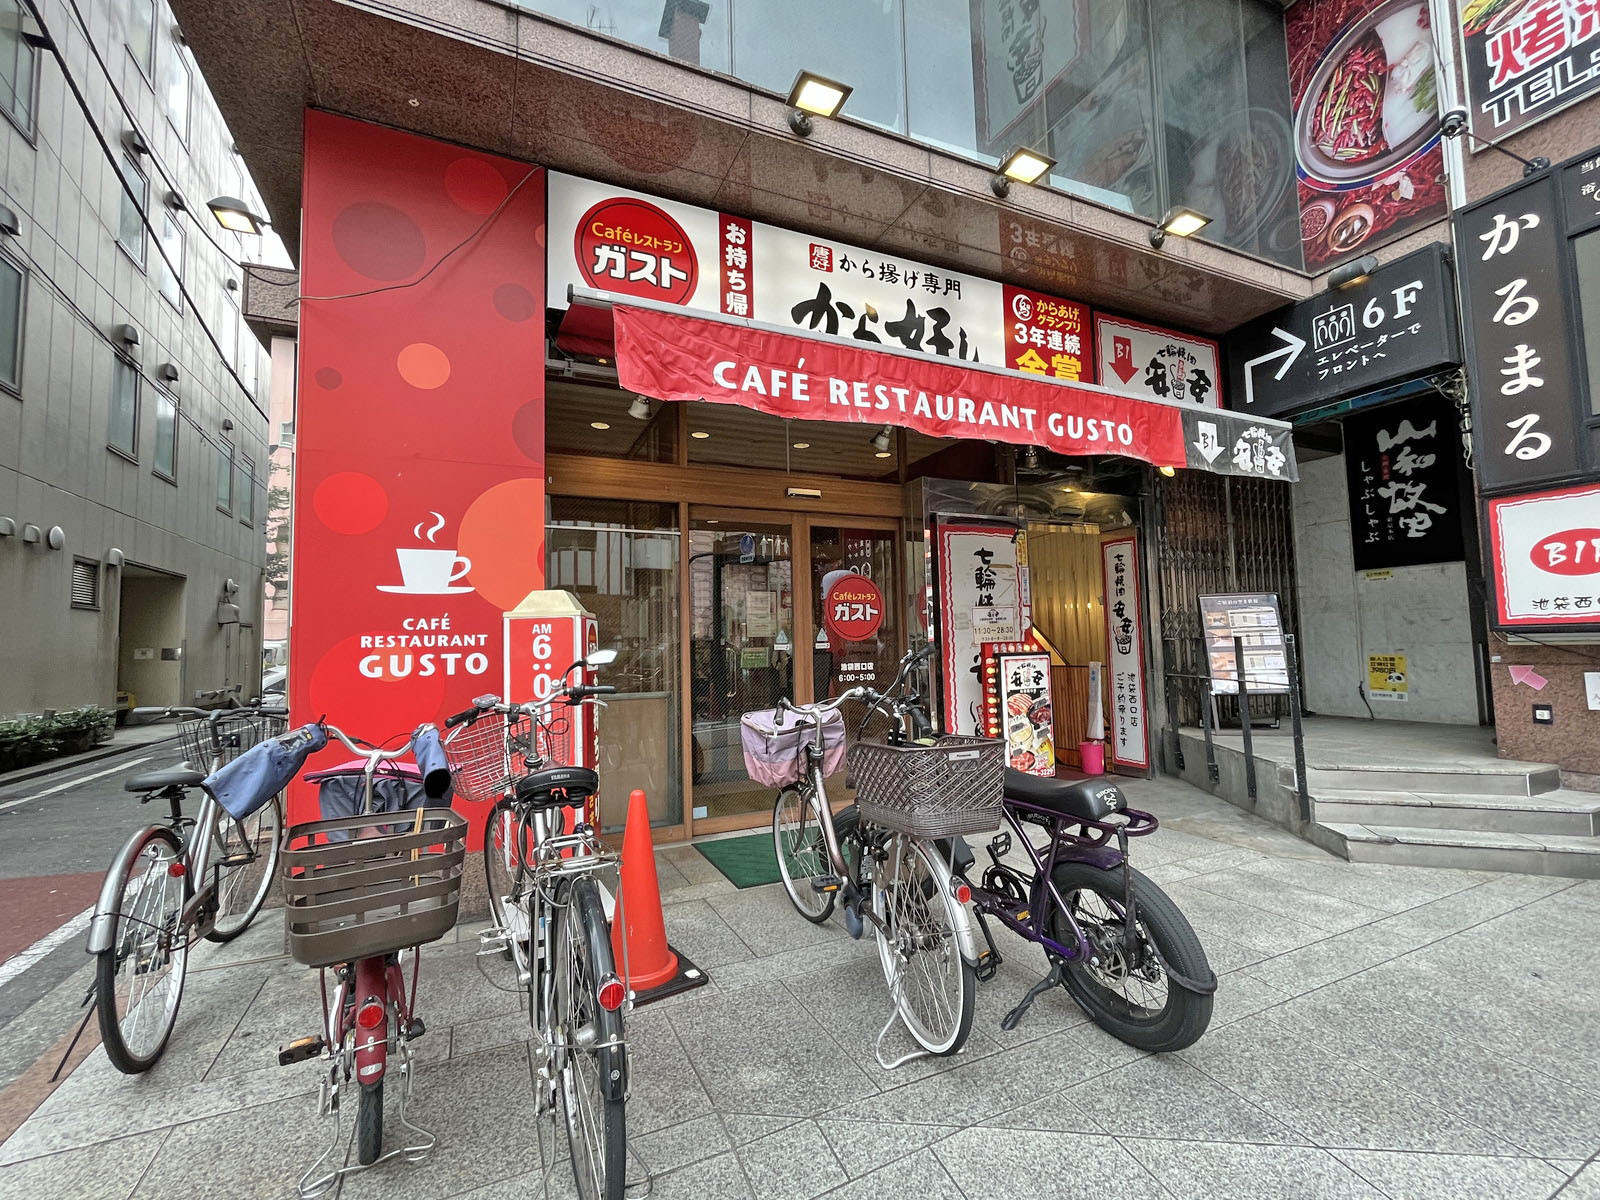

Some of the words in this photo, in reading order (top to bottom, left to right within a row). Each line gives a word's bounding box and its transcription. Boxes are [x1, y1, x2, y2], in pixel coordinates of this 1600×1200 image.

[591, 221, 683, 254] Caféレストラン
[592, 243, 688, 290] ガスト
[838, 253, 962, 300] から揚げ専門
[1036, 299, 1080, 320] からあげ
[1362, 280, 1424, 329] 6F
[1037, 313, 1081, 333] グランプリ
[1014, 322, 1081, 356] 3年連続
[1316, 322, 1422, 366] エレベーターで
[1479, 213, 1552, 461] かるまる
[1115, 342, 1130, 360] B1
[1318, 352, 1387, 381] フロントへ
[712, 357, 811, 402] CAFÉ
[828, 377, 1038, 432] RESTAURANT
[1047, 412, 1134, 447] GUSTO
[1360, 461, 1380, 543] しゃぶしゃぶ
[833, 591, 876, 601] Caféレストラン
[402, 613, 451, 631] CAFÉ
[834, 602, 879, 622] ガスト
[360, 634, 488, 649] RESTAURANT
[532, 624, 552, 634] AM
[358, 653, 489, 679] GUSTO
[1095, 787, 1118, 798] BRONX
